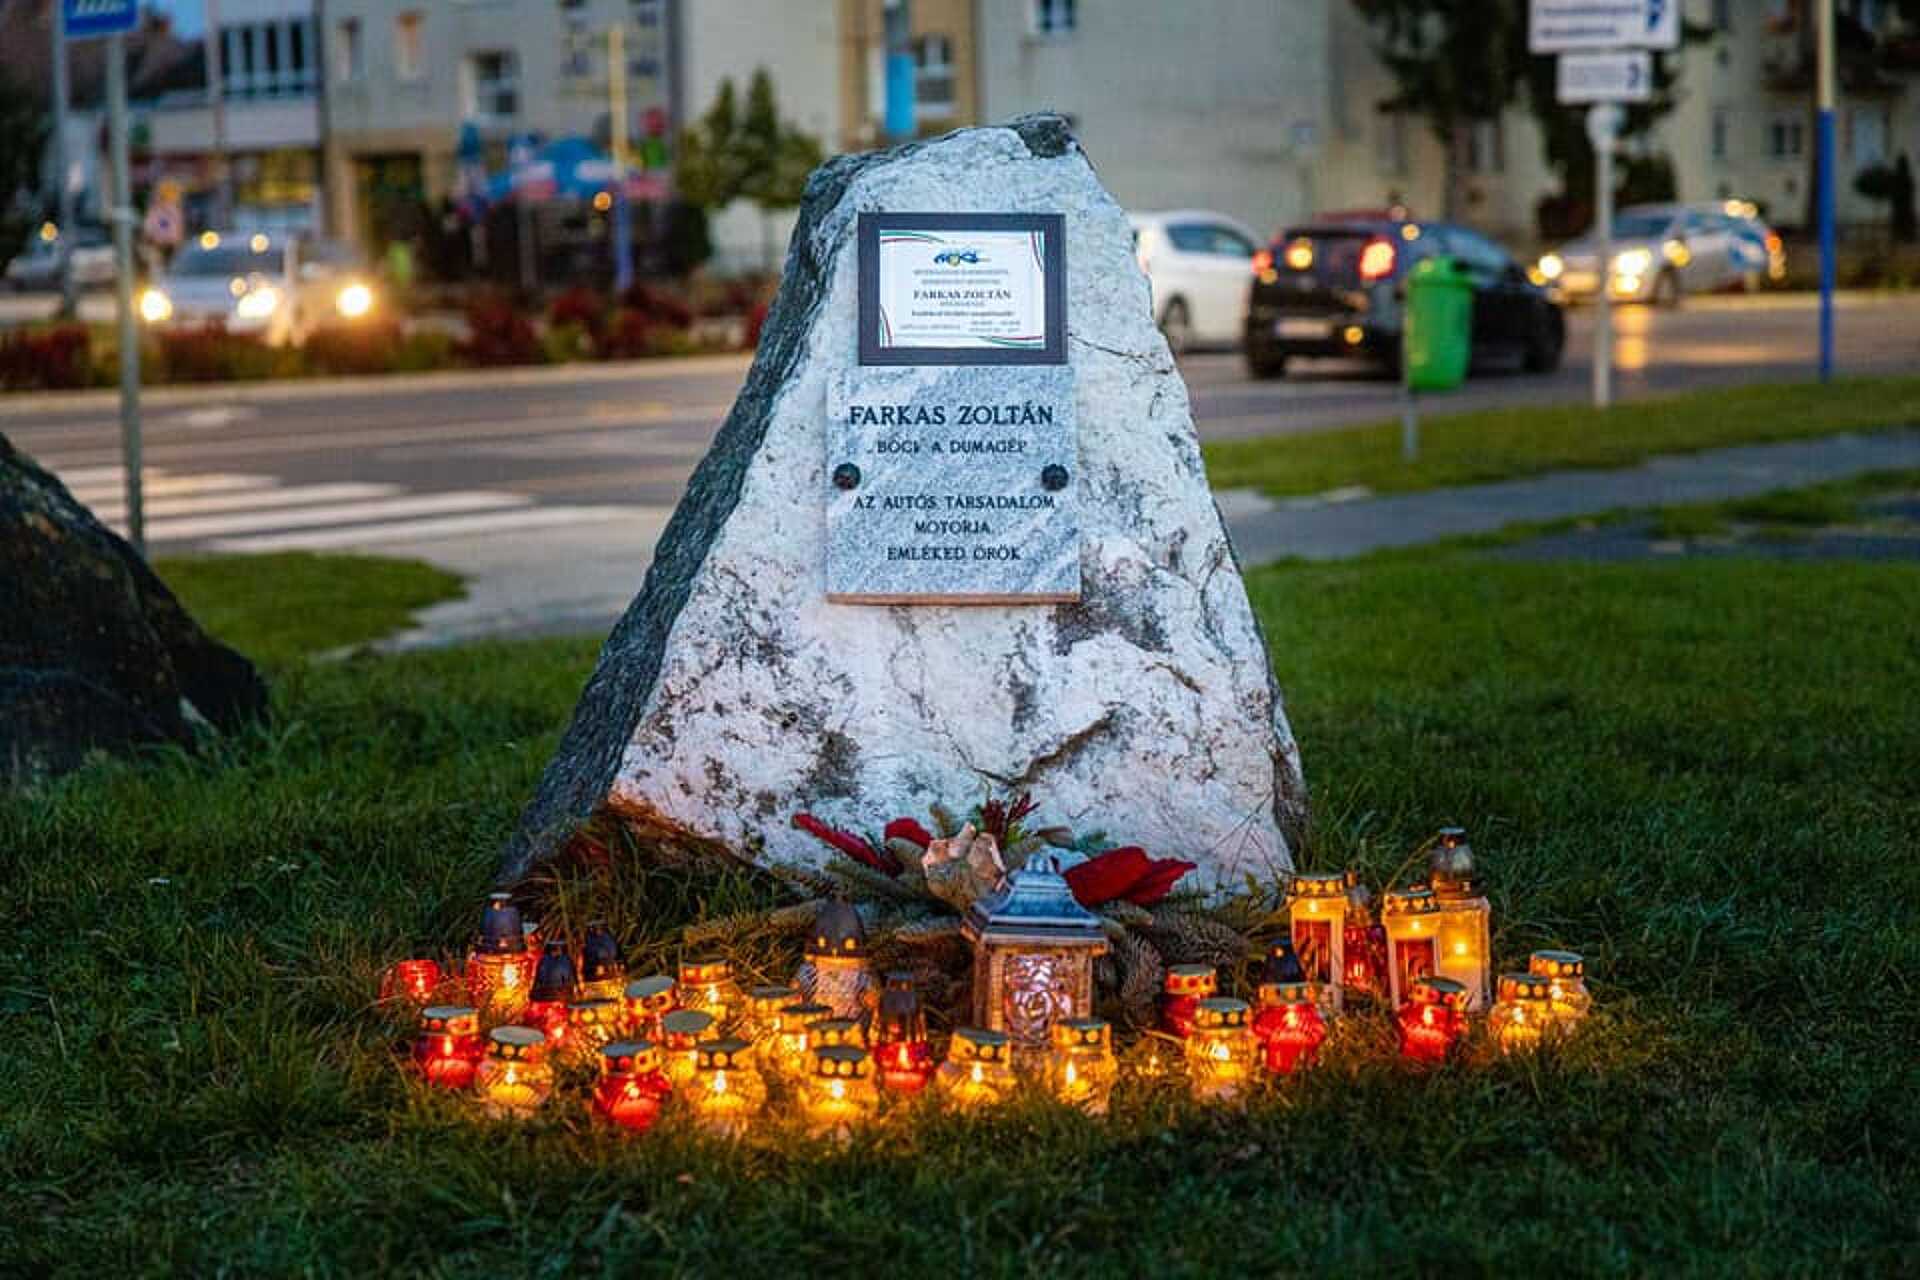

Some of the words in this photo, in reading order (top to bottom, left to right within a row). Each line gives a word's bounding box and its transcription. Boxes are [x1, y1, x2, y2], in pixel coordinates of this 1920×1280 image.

[850, 405, 947, 425] FARKAS
[959, 400, 1053, 425] ZOLTÁN
[931, 440, 944, 453] A
[853, 496, 875, 509] AZ
[887, 545, 966, 560] EMLÉKED
[973, 544, 1021, 560] ÖRÖK
